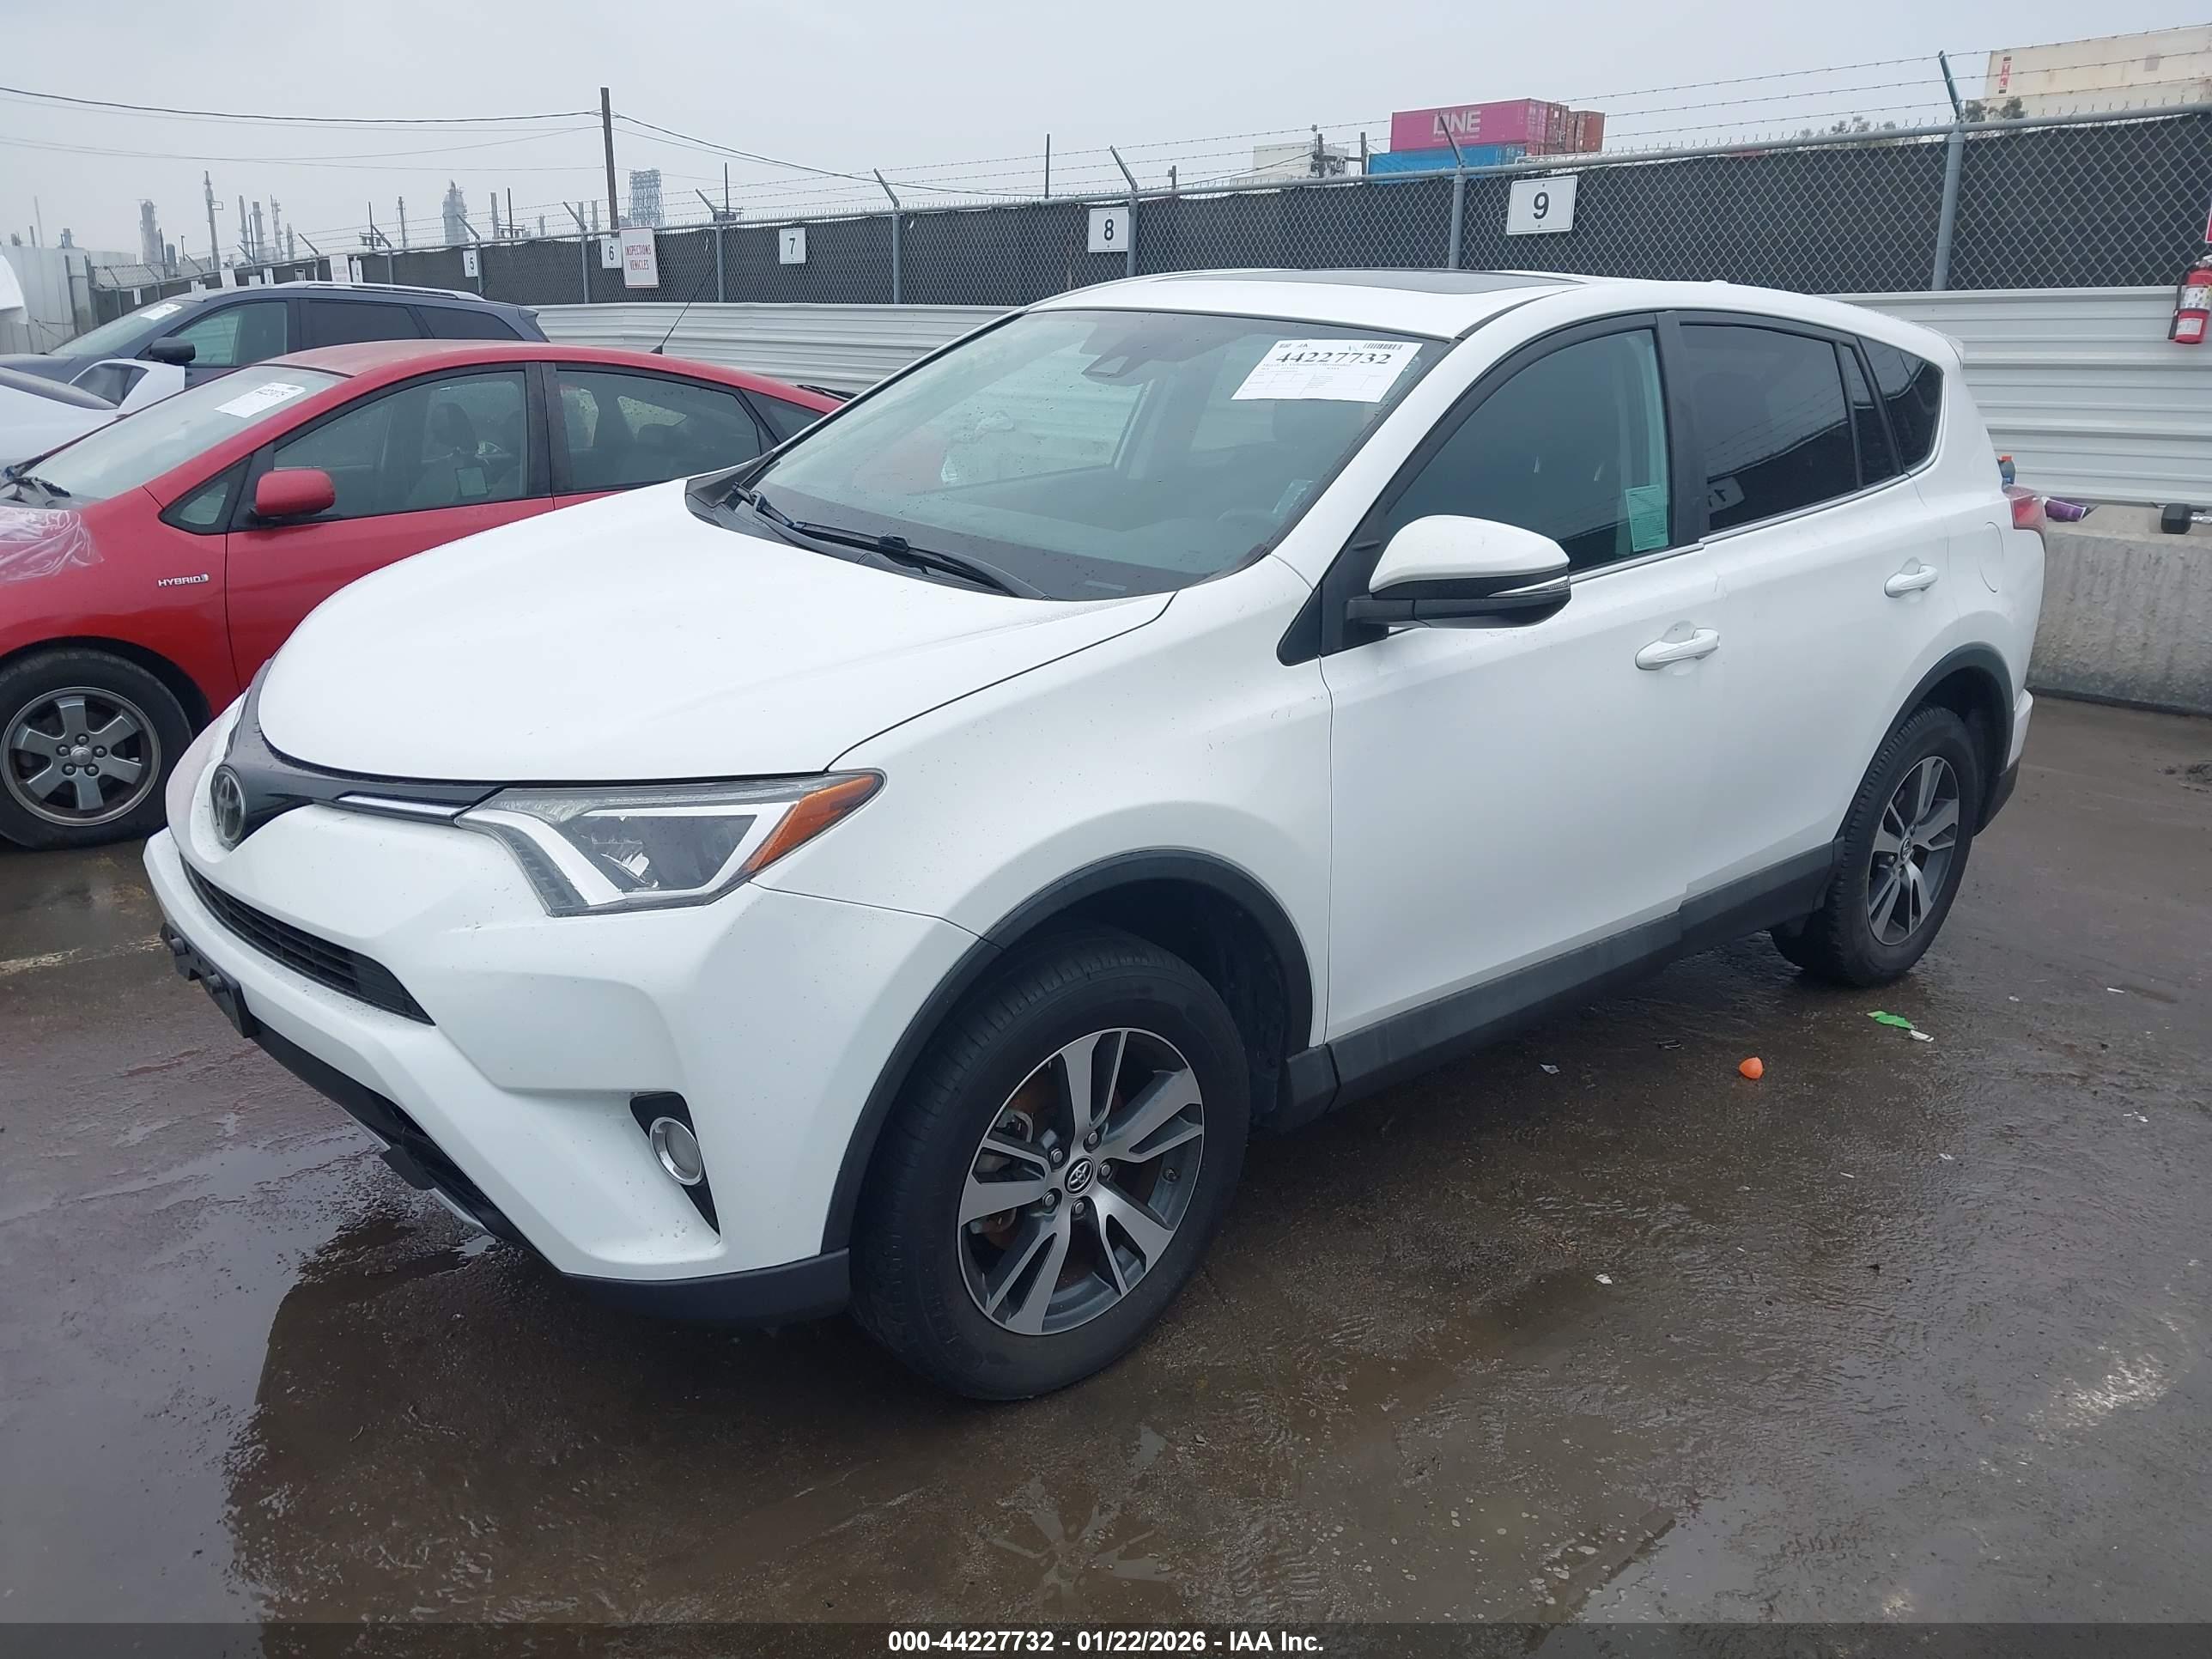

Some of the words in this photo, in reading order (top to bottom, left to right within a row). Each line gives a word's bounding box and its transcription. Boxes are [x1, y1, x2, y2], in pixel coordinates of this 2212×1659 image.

[1533, 191, 1549, 219] 9
[1103, 218, 1114, 241] 8
[624, 245, 652, 256] INSPECTIONS
[789, 237, 797, 255] 7
[609, 246, 614, 261] 6
[470, 257, 474, 270] 5
[629, 259, 650, 270] VEHICLES
[1275, 351, 1392, 365] 44227732
[158, 575, 200, 586] HYBRID
